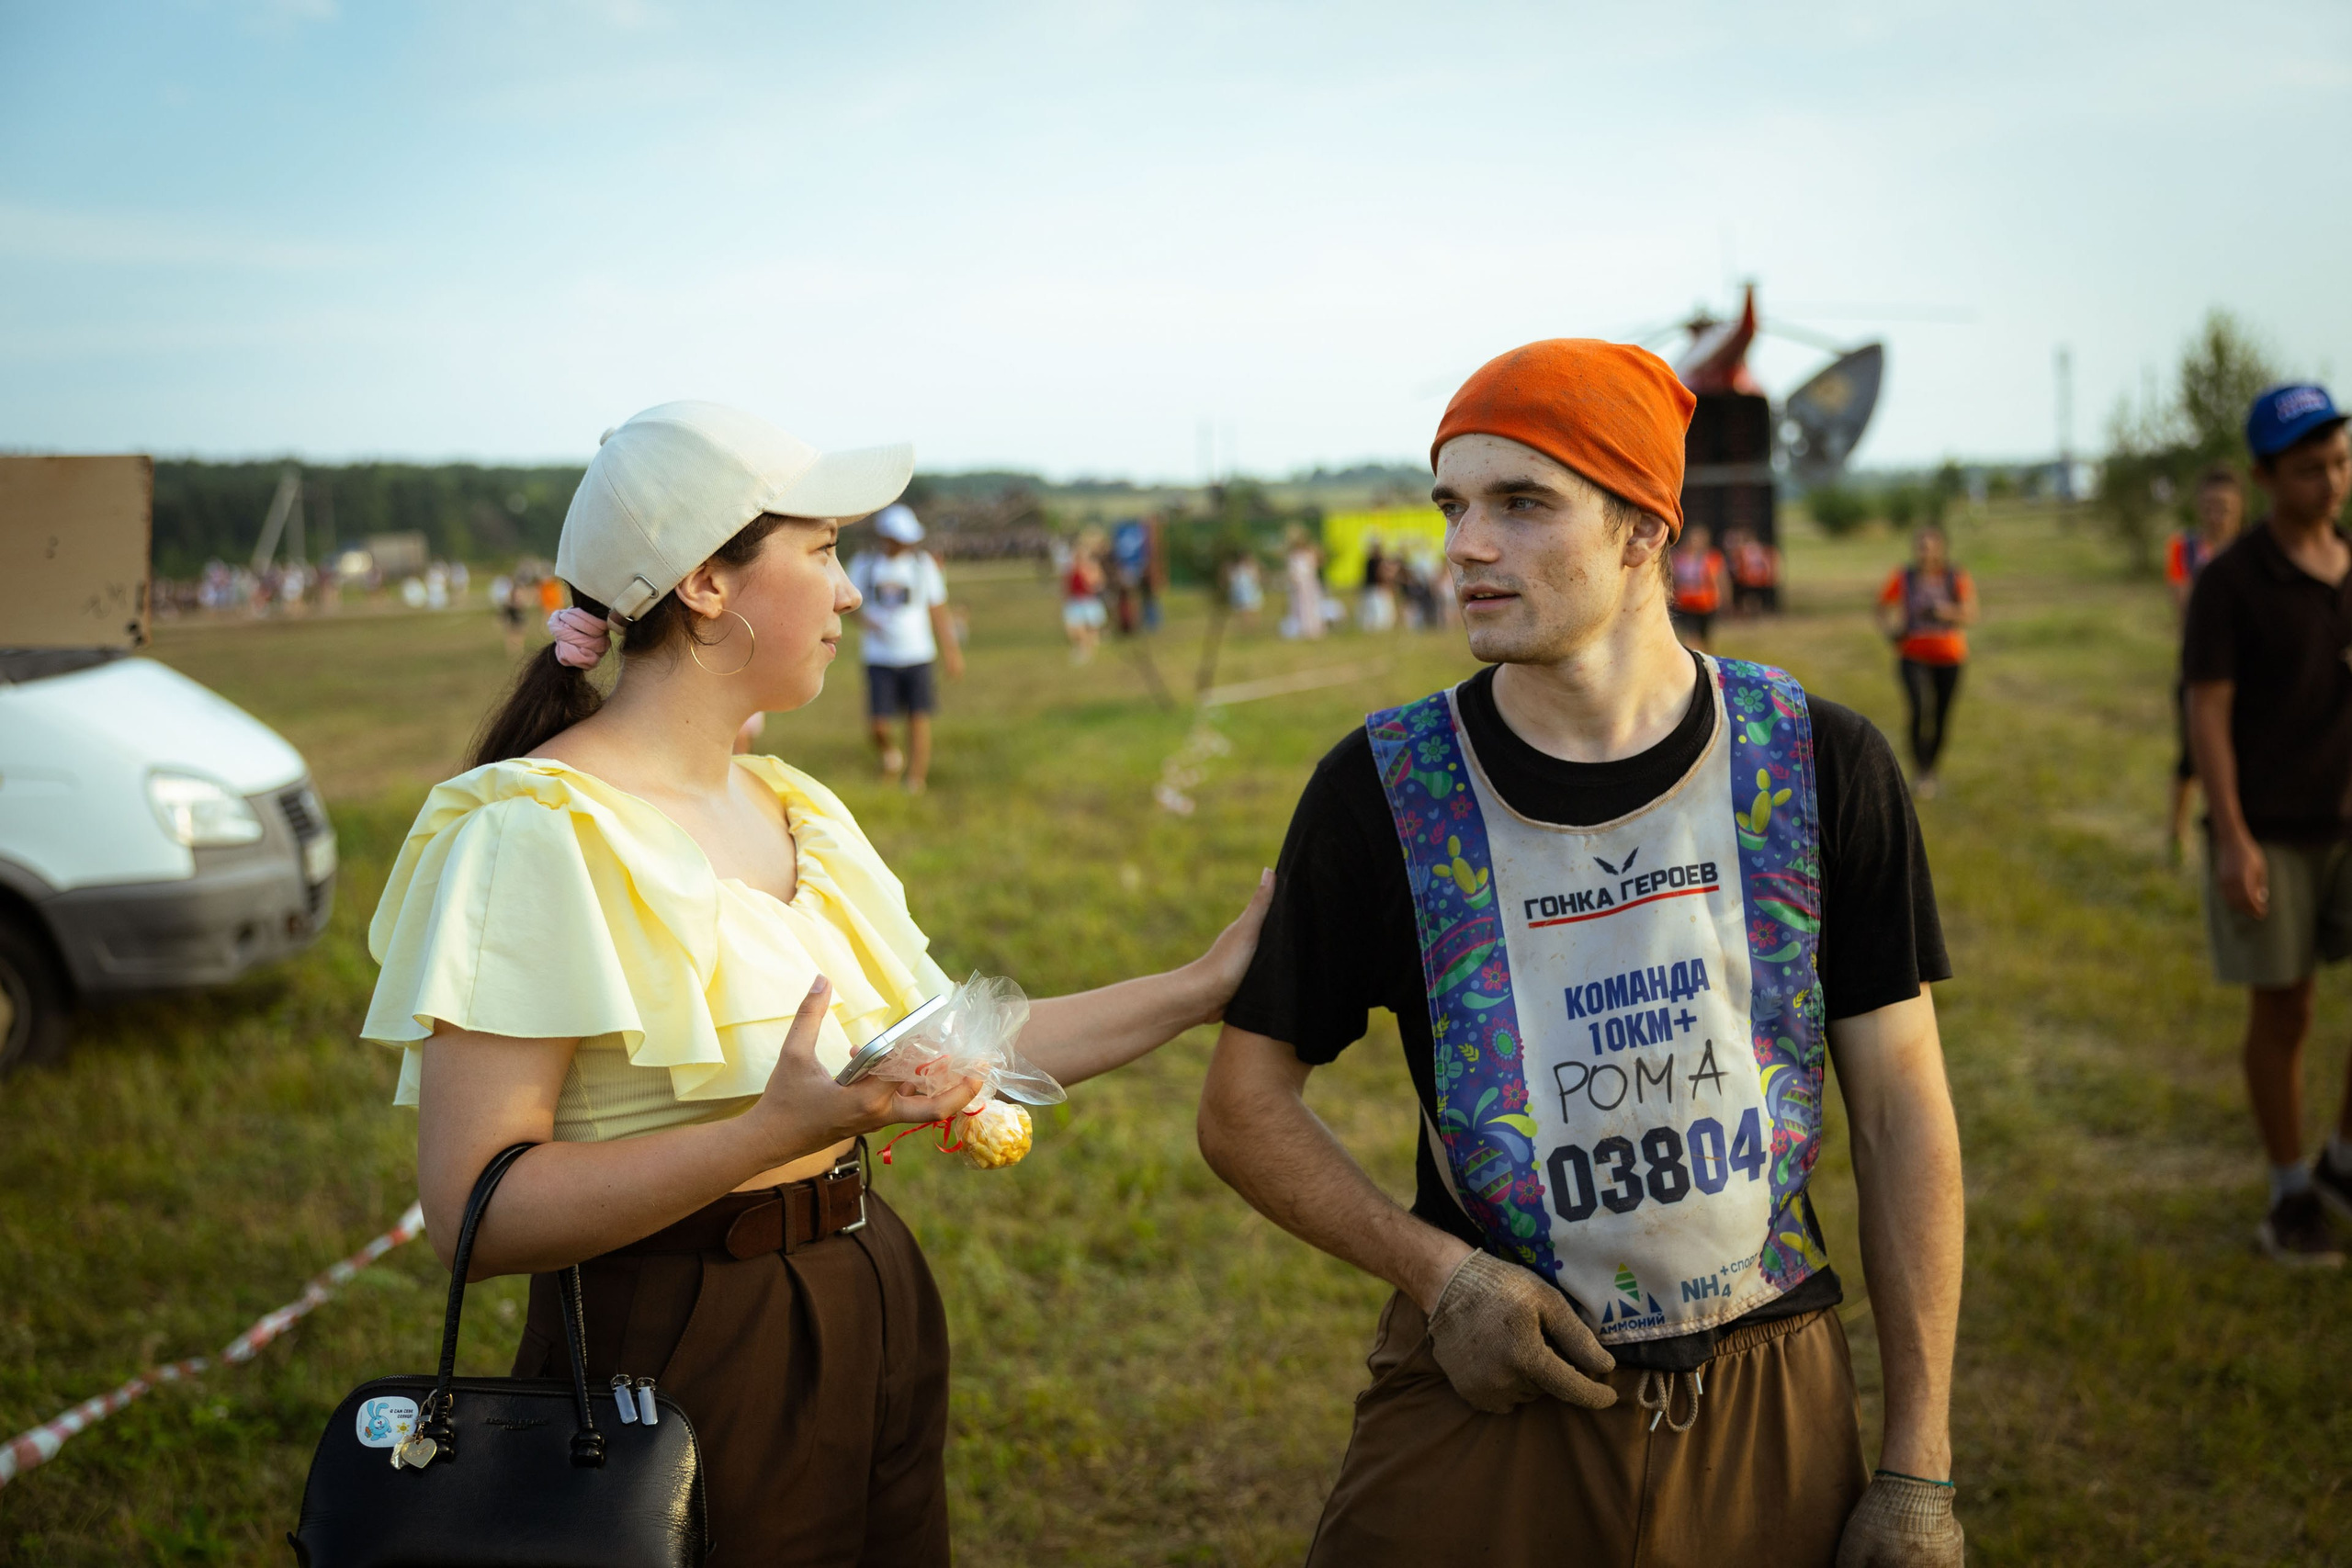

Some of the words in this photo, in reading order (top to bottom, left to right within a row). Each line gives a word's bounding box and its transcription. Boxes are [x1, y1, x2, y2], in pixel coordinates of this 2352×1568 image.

[1524, 887, 1614, 919] ГОНКА
[1620, 862, 1718, 901] ГЕРОЕВ
[1565, 958, 1711, 1021] КОМАНДА
[1589, 1008, 1697, 1055] 10КМ+
[1553, 1039, 1728, 1123] РОМА
[1546, 1107, 1767, 1223] 03804
[1600, 1313, 1666, 1335] АММОНИЙ
